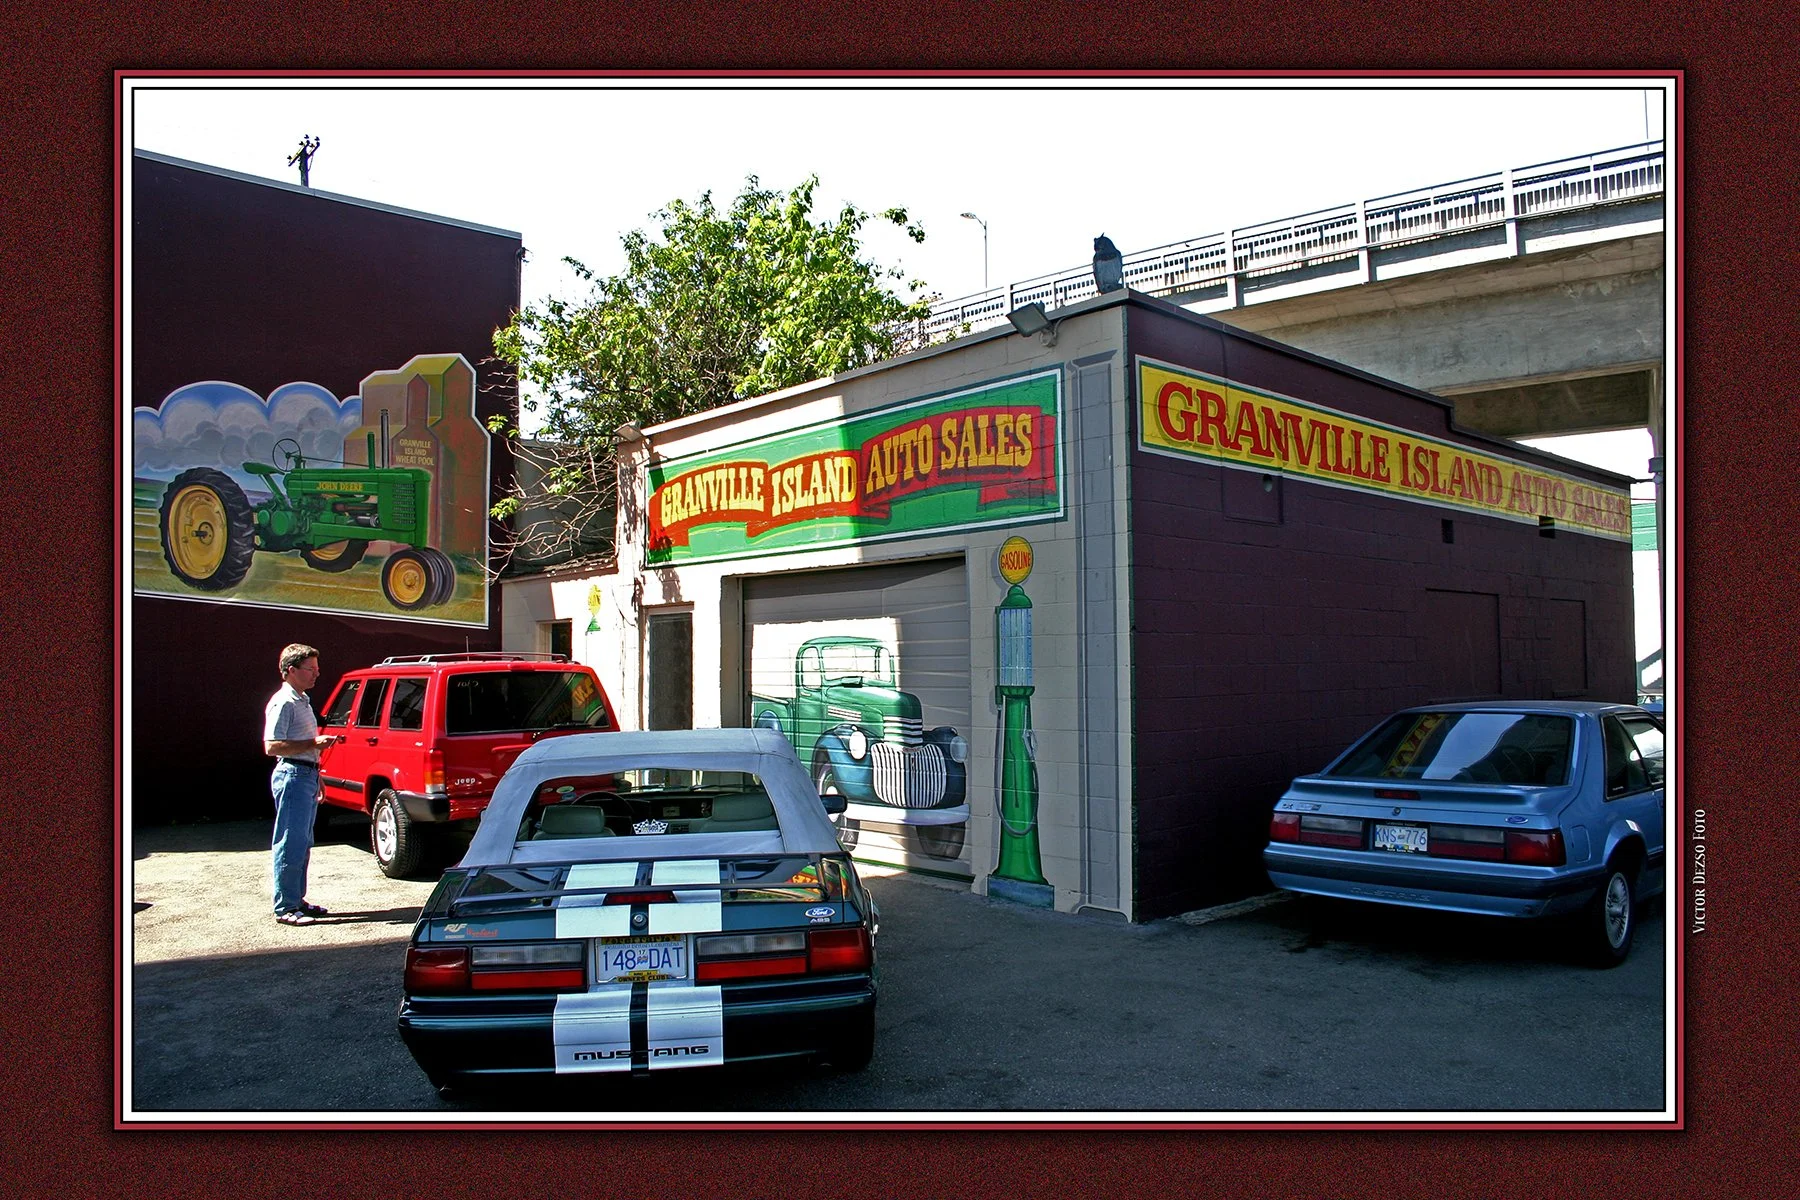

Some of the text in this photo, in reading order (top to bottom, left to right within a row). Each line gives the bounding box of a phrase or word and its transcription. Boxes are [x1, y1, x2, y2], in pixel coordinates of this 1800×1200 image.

[400, 438, 432, 449] GRANVILLE
[405, 447, 427, 456] ISLAND
[1157, 380, 1628, 531] GRANVILLE ISLAND AUTO SALES
[418, 456, 434, 466] POOL
[661, 412, 1033, 527] GRANVILLE ISLAND AUTO SALES
[317, 481, 363, 492] JOHN DEERE
[1000, 551, 1031, 570] GASOLINE
[455, 777, 475, 786] Jeep
[1404, 829, 1427, 846] 776
[603, 949, 637, 971] 148
[649, 947, 684, 969] DAT
